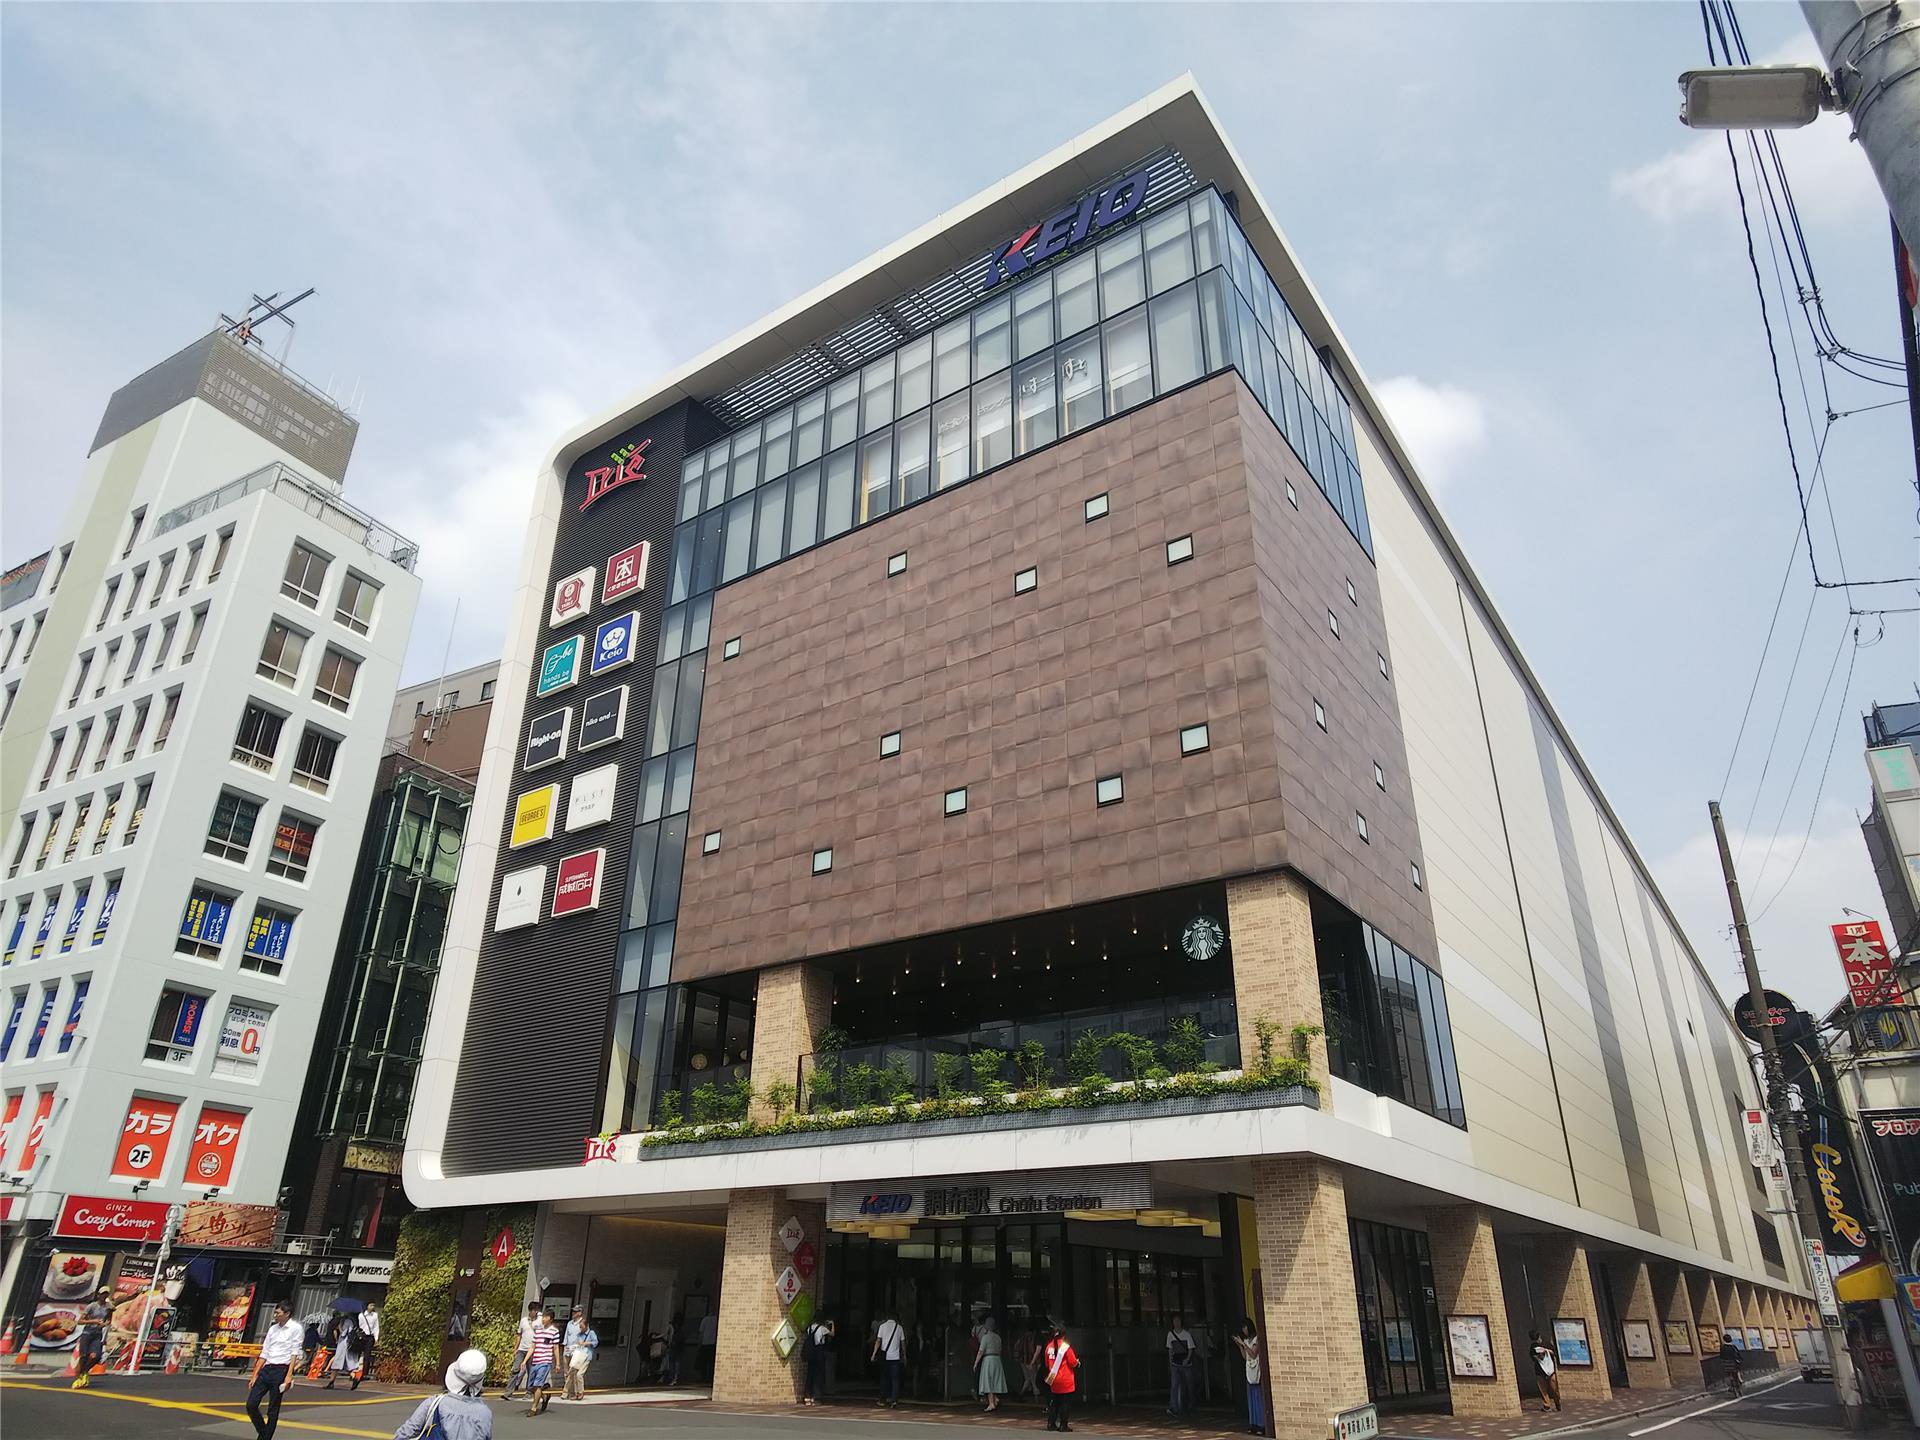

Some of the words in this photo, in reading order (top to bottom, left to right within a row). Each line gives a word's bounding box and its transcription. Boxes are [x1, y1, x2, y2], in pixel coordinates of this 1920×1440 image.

[983, 169, 1150, 291] KEIO
[599, 647, 623, 663] Keio
[530, 729, 562, 748] Right-on
[1842, 938, 1885, 965] 本
[182, 999, 199, 1034] PROMISE
[172, 1051, 187, 1062] 3F
[125, 1110, 173, 1136] カラ
[194, 1122, 239, 1146] オケ
[130, 1149, 151, 1163] 2F
[105, 1203, 133, 1213] GINZA
[860, 1193, 913, 1215] KEIO
[924, 1187, 989, 1217] 調布駅
[73, 1208, 113, 1232] Cozy
[112, 1213, 156, 1229] Corner
[496, 1235, 508, 1257] A
